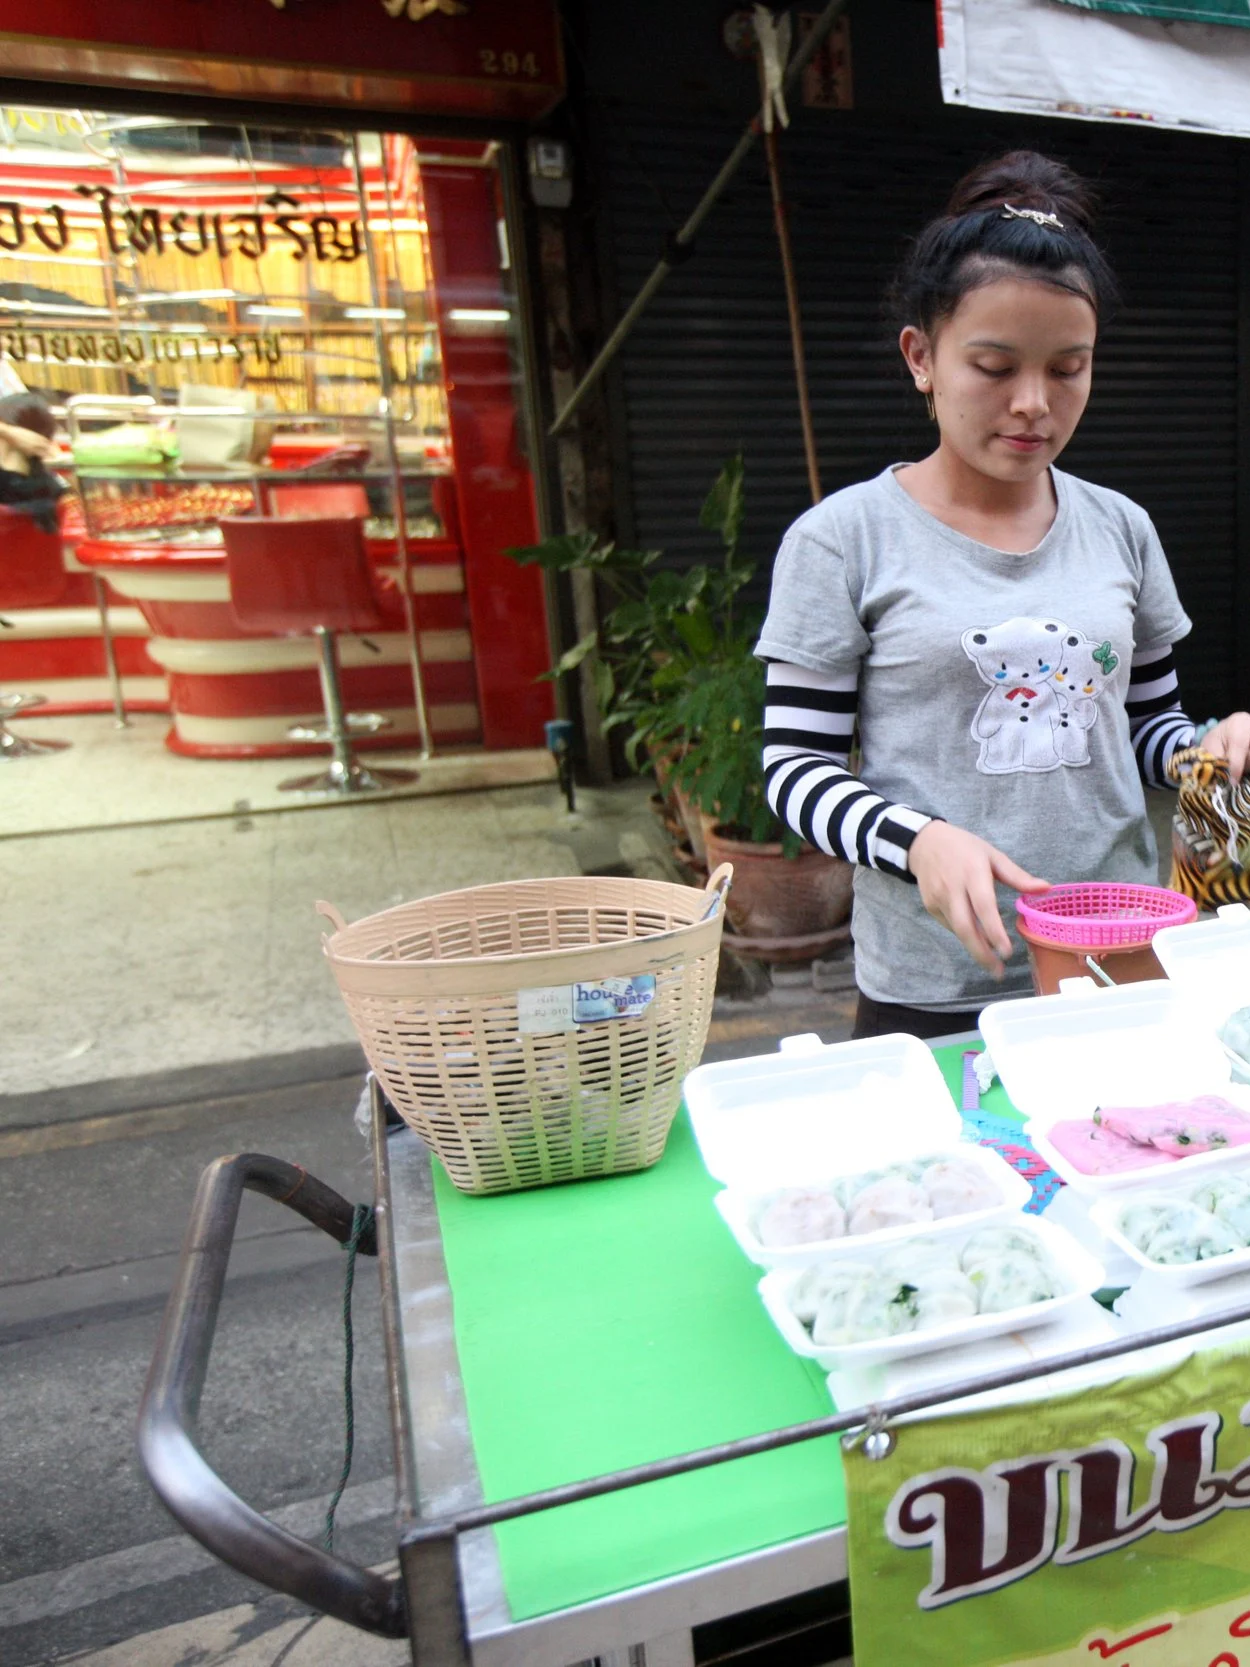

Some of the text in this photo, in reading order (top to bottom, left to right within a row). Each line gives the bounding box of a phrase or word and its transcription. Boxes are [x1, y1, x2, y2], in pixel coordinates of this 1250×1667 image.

[479, 49, 541, 76] 294
[577, 984, 634, 1001] houe
[614, 992, 652, 1007] mate
